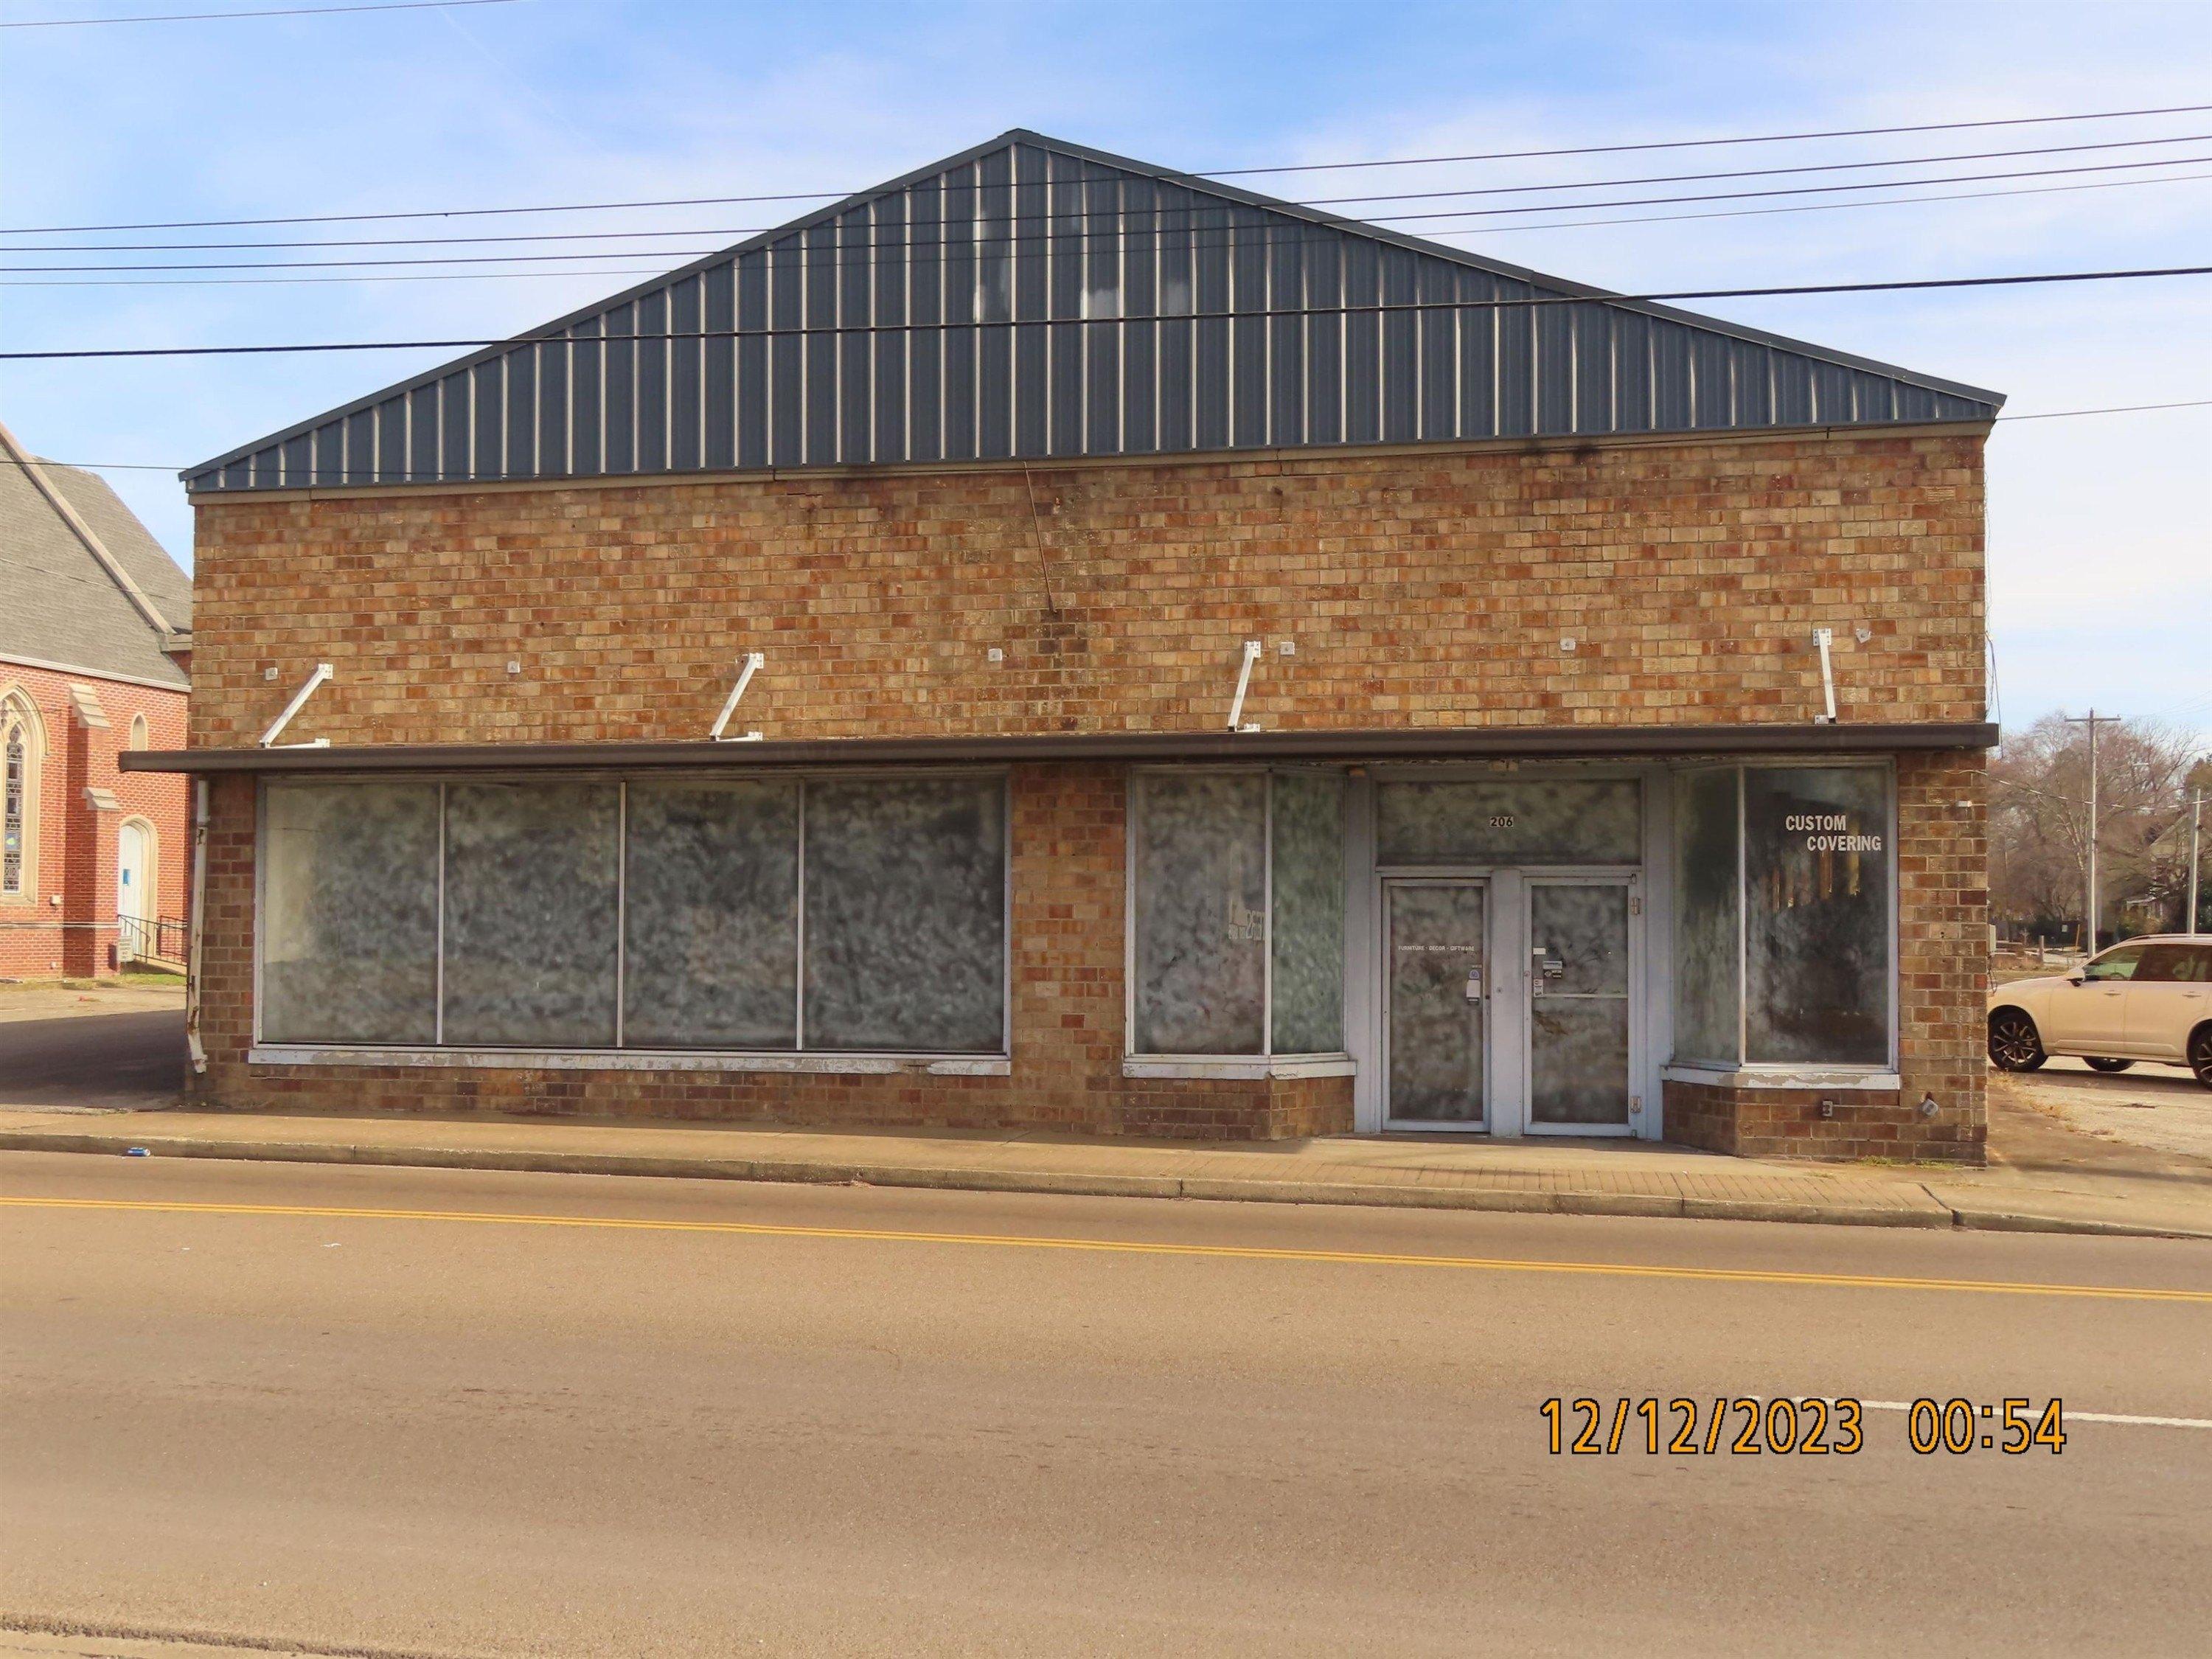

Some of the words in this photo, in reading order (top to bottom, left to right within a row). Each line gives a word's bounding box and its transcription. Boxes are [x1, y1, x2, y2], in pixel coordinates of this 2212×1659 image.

[1490, 817, 1512, 827] 206
[1785, 815, 1846, 831] CUSTOM
[1806, 835, 1882, 851] COVERING
